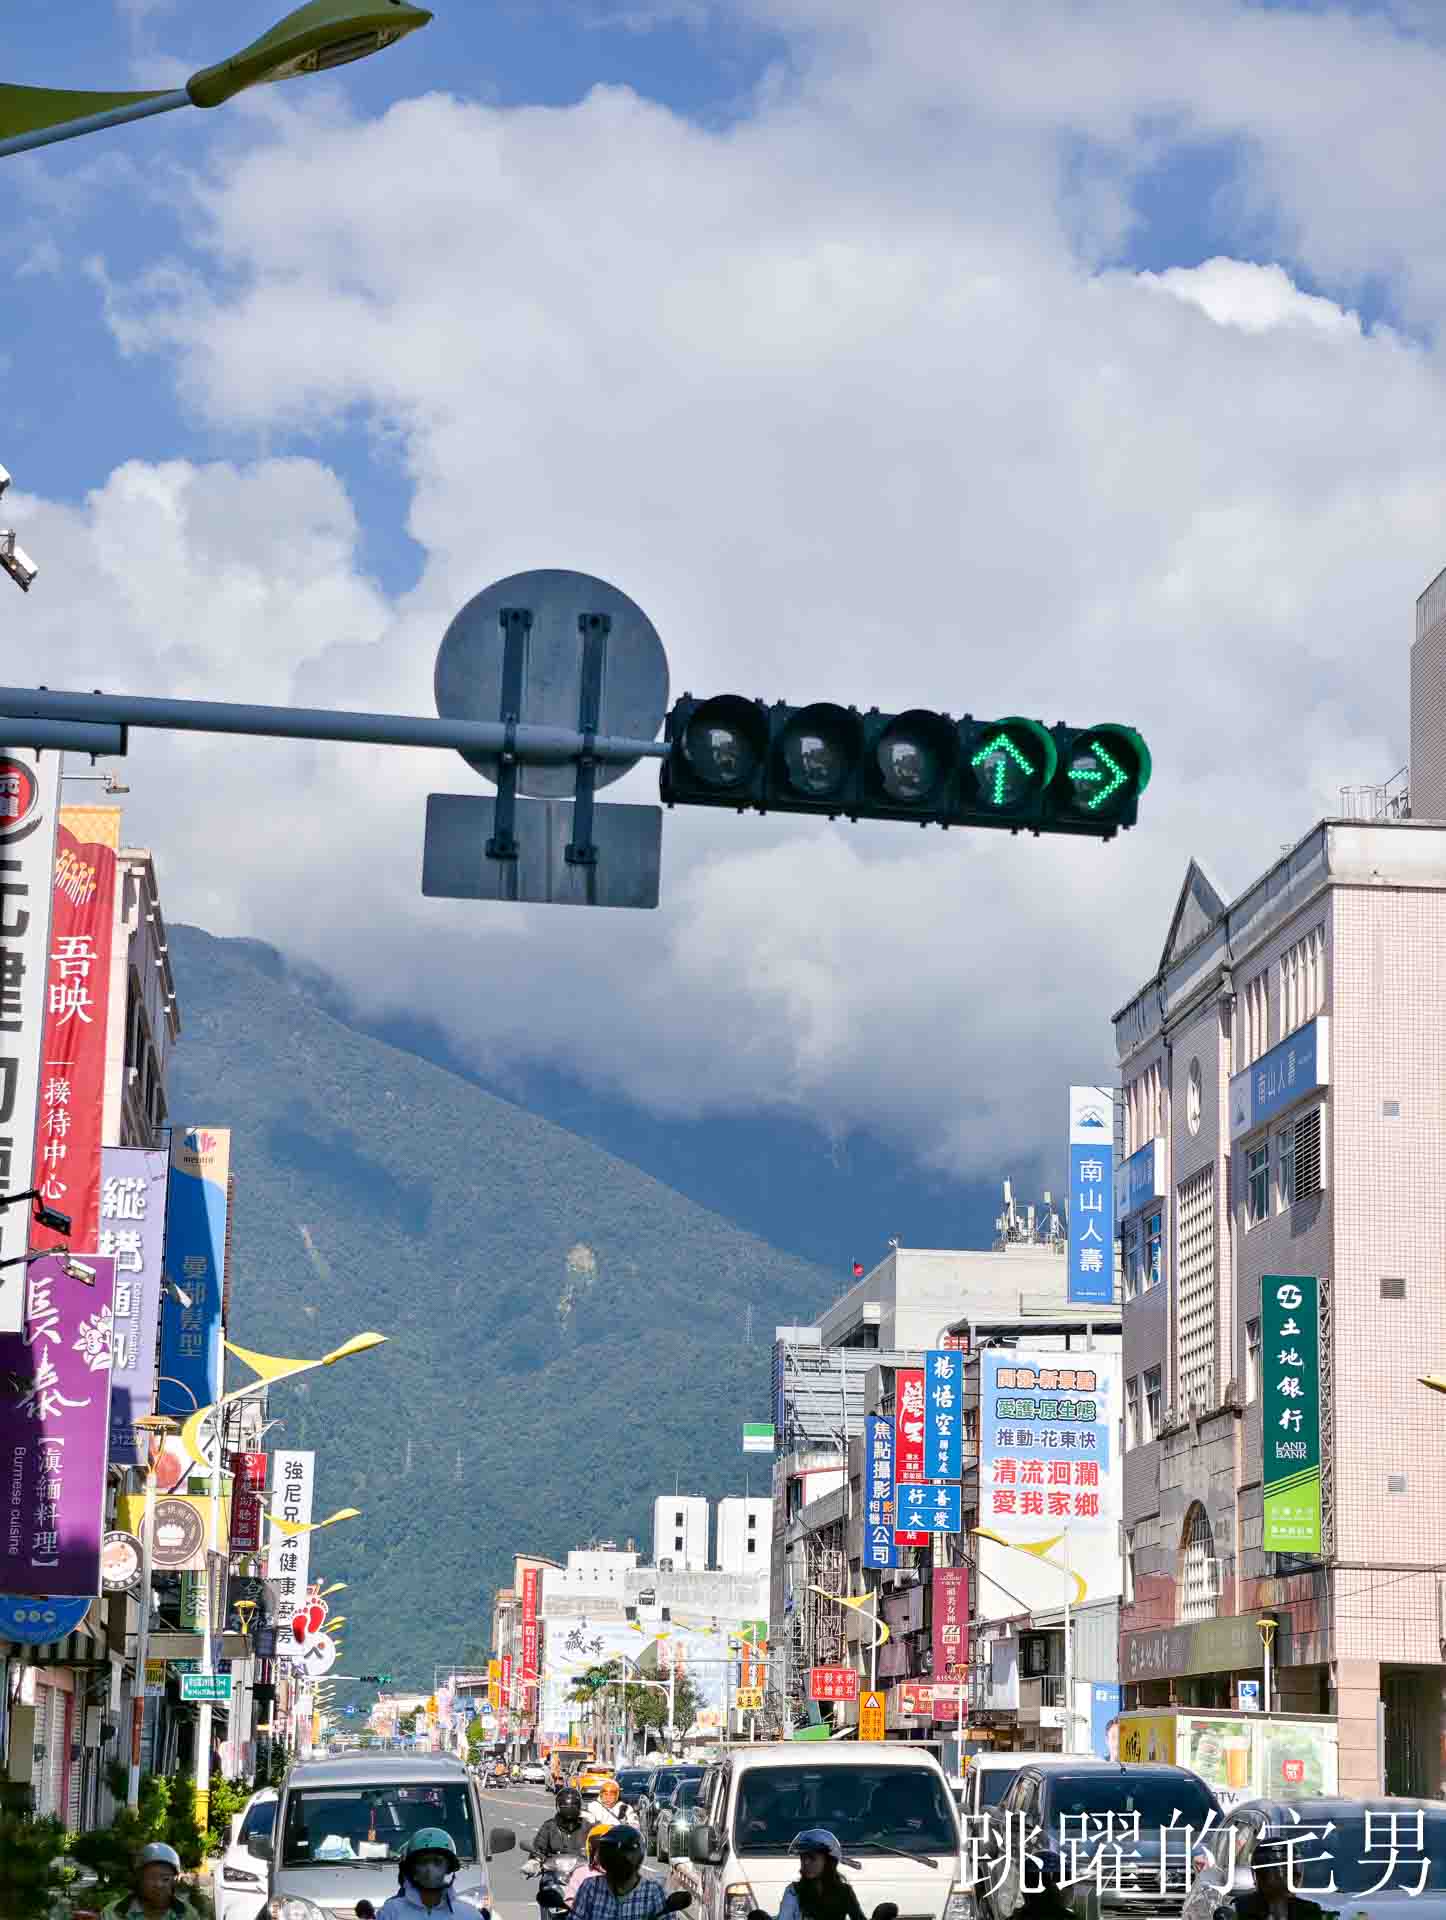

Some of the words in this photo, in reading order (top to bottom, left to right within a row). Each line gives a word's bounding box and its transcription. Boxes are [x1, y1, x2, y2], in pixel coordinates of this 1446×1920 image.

[40, 1077, 72, 1200] 接待中心
[1079, 1159, 1103, 1273] 南山人壽
[1276, 1318, 1304, 1434] 土地銀行
[996, 1399, 1097, 1422] 愛護-原生態
[996, 1429, 1097, 1449] 推動-花東快
[1275, 1440, 1307, 1450] LAND
[1275, 1449, 1307, 1460] BANK
[12, 1446, 27, 1505] Burmese
[992, 1458, 1099, 1487] 清流洄瀾
[992, 1490, 1099, 1517] 愛我家鄉
[8, 1511, 21, 1554] cuisine
